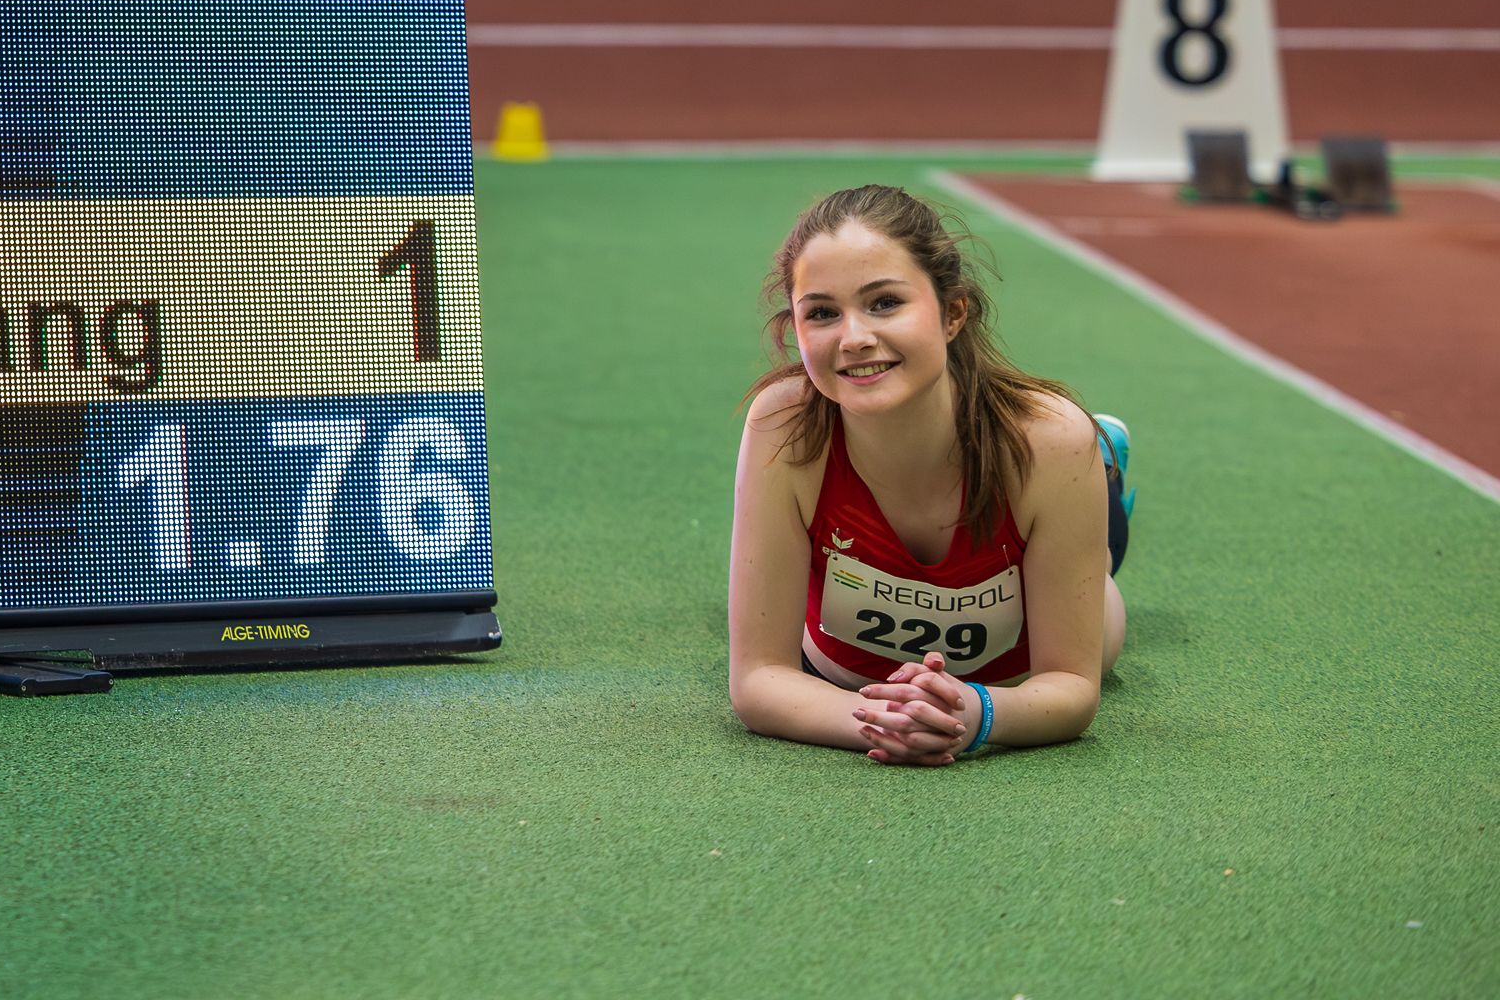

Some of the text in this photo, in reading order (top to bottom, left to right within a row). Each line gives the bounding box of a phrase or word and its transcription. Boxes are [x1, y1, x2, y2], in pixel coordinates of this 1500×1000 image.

[377, 217, 444, 363] 1
[115, 414, 475, 571] 1.76
[873, 579, 1015, 612] REGUPOL
[220, 623, 311, 642] ALGE-TIMING
[855, 608, 988, 662] 229
